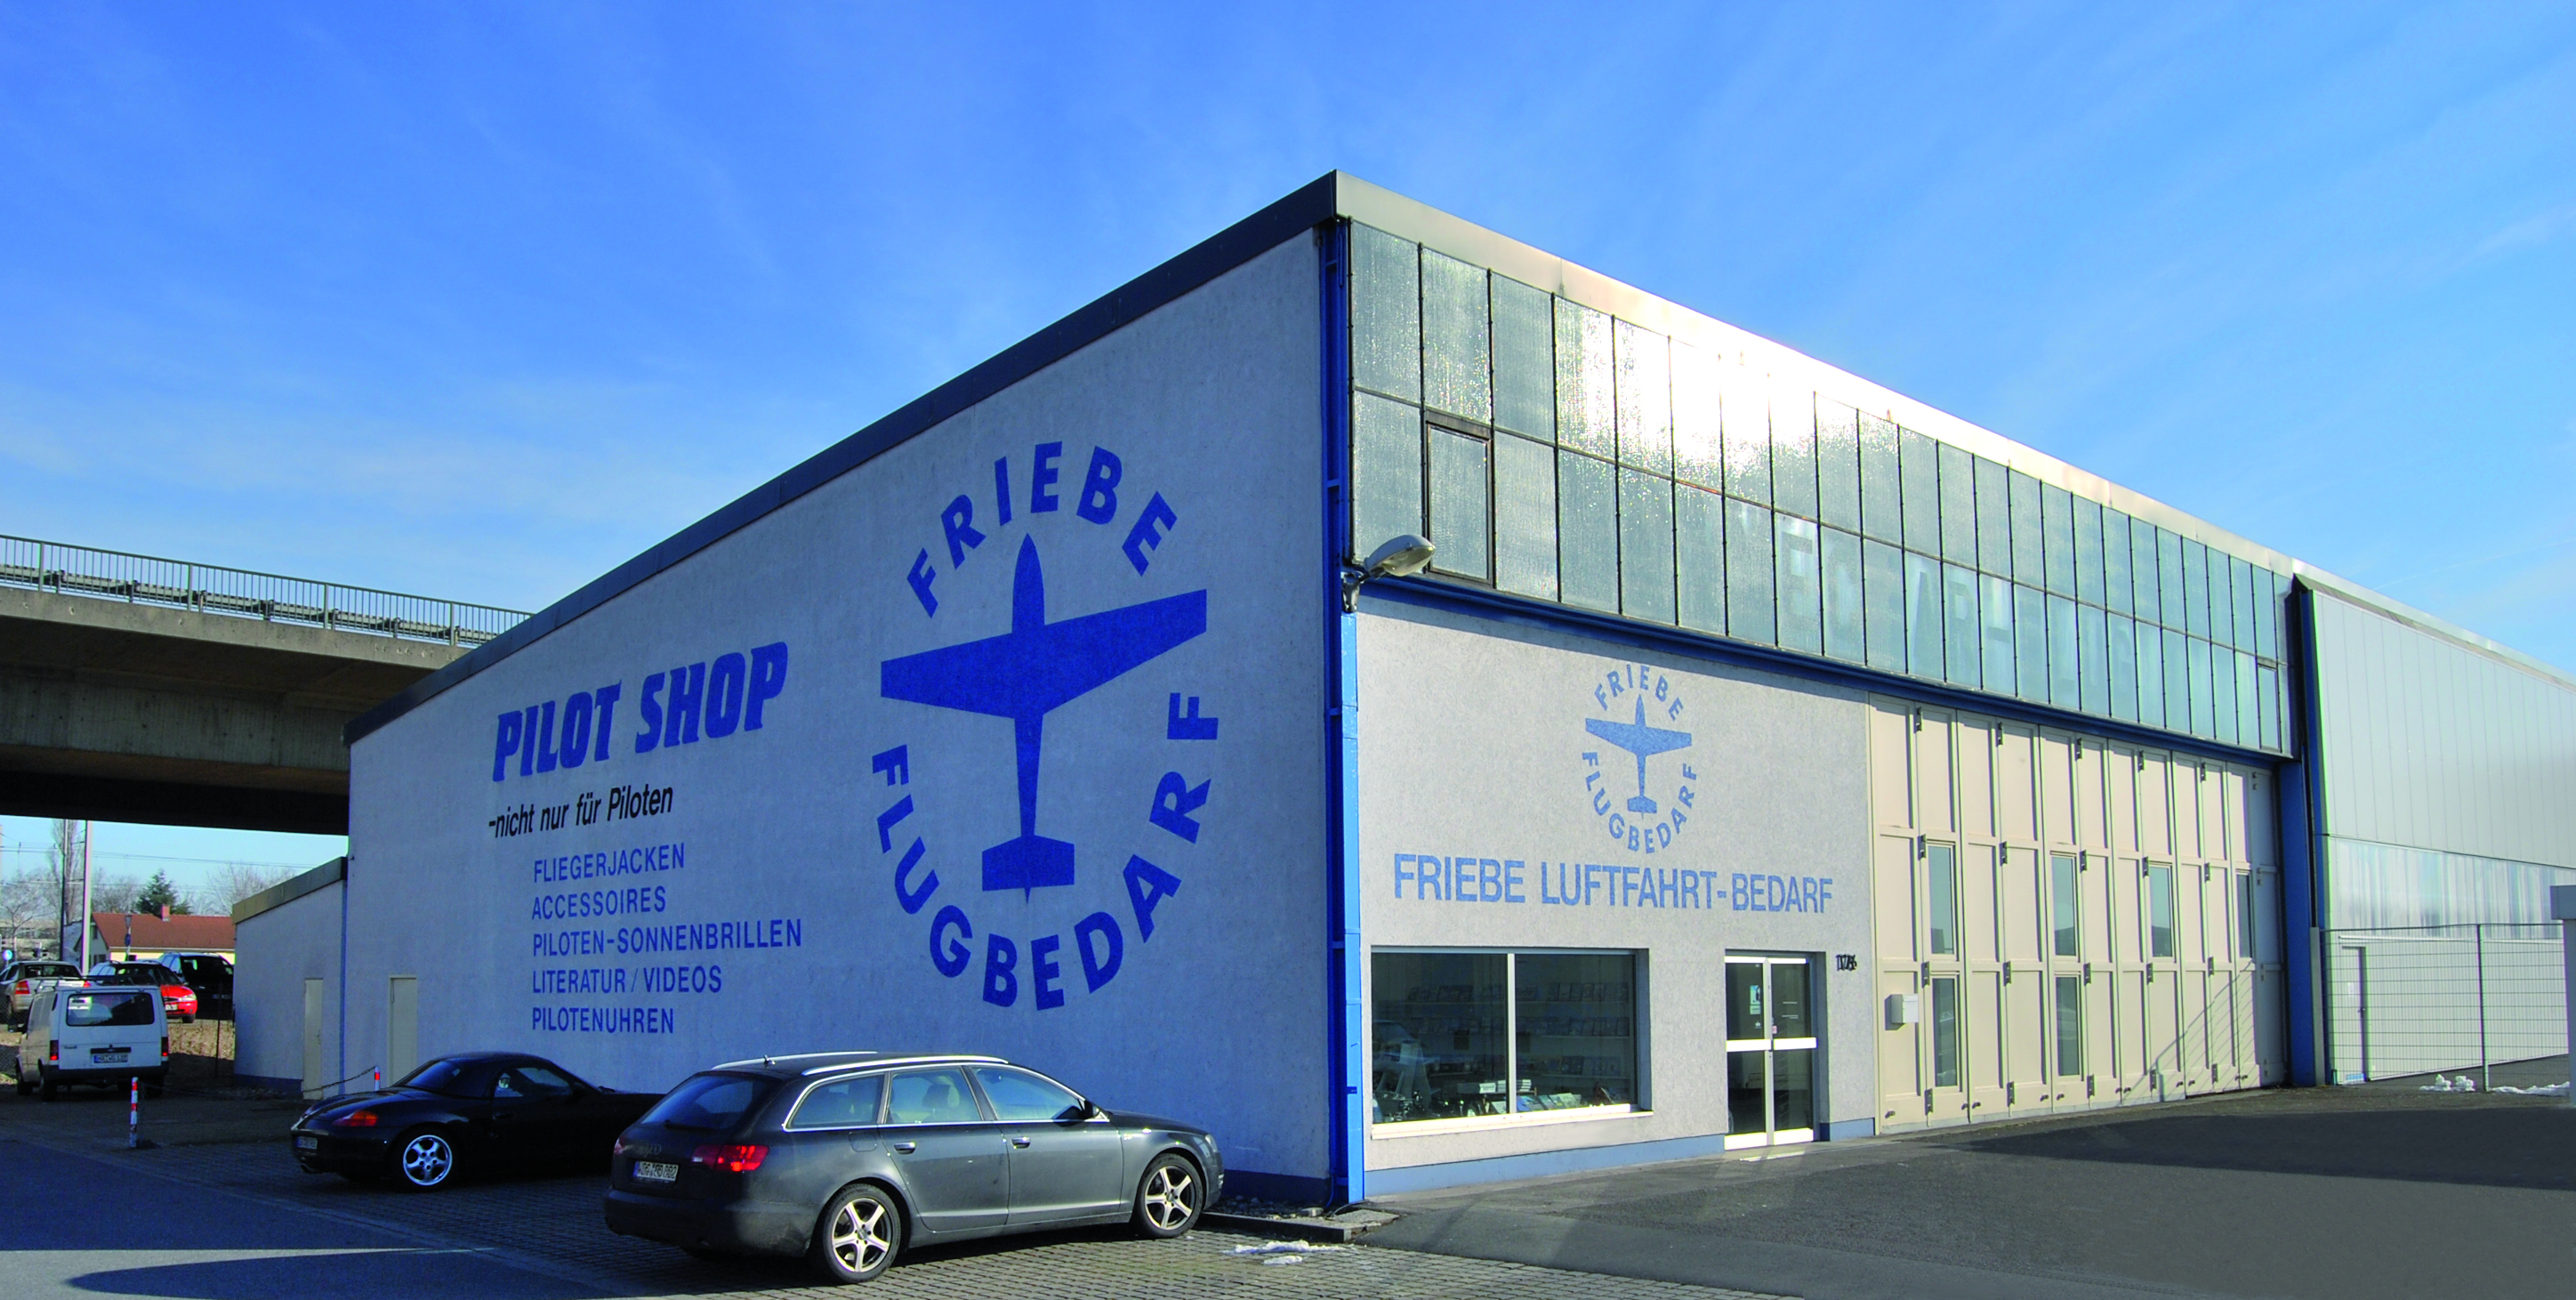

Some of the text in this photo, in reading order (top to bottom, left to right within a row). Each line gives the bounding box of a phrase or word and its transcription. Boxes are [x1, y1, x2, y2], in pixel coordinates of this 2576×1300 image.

[906, 440, 1179, 619] FRIEBE
[492, 641, 789, 783] PILOT SHOP
[1594, 664, 1685, 722] FRIEBE
[488, 784, 674, 838] -nicht nur für Piloten
[1582, 751, 1698, 854] FLUGBEDARF
[534, 842, 686, 884] FLIEGERJACKEN
[872, 692, 1220, 1012] FLUGBEDARF
[531, 885, 666, 920] ACCESSOIRES
[1394, 853, 1833, 914] FRIEBE LUFTFAHRT-BEDARF
[533, 918, 802, 957] PILOTEN-SONNENBRILLEN
[533, 968, 626, 995] LITERATUR
[642, 964, 722, 994] VIDEOS
[532, 1006, 675, 1035] PILOTENUHREN
